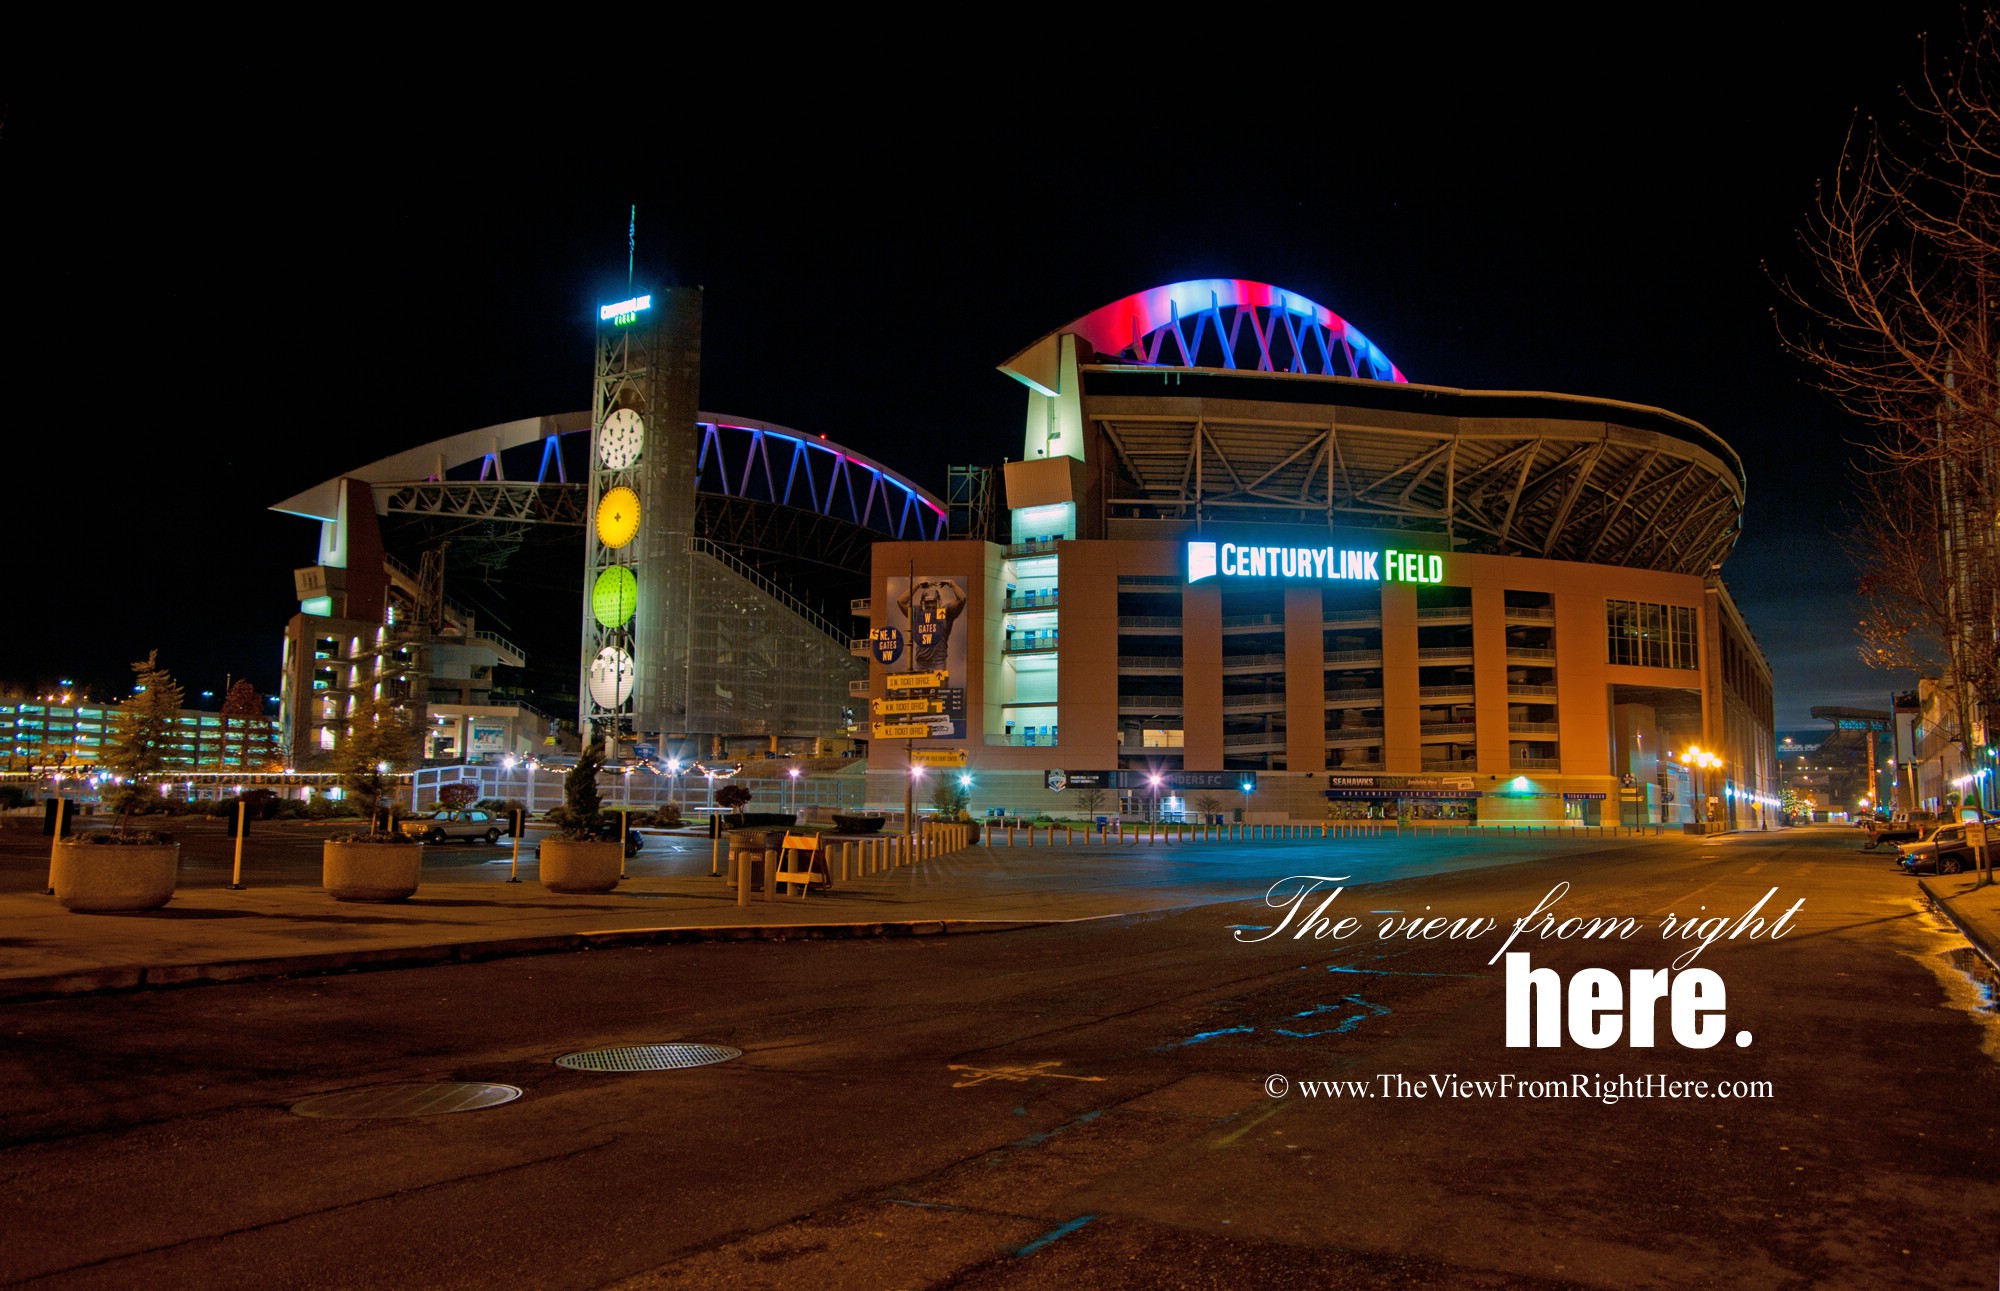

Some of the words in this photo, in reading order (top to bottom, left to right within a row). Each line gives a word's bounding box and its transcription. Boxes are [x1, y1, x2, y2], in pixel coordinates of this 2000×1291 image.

[1385, 549, 1443, 583] FIELD
[924, 612, 931, 623] W
[918, 624, 936, 633] GATES
[922, 634, 932, 645] SW
[879, 642, 897, 650] GATES
[882, 651, 893, 662] NW
[900, 678, 914, 686] TICKET
[915, 677, 930, 685] OFFICE
[911, 702, 925, 710] OFFICE
[910, 727, 924, 735] OFFICE
[1207, 775, 1222, 785] FC
[1332, 777, 1374, 786] SEAHAWKS
